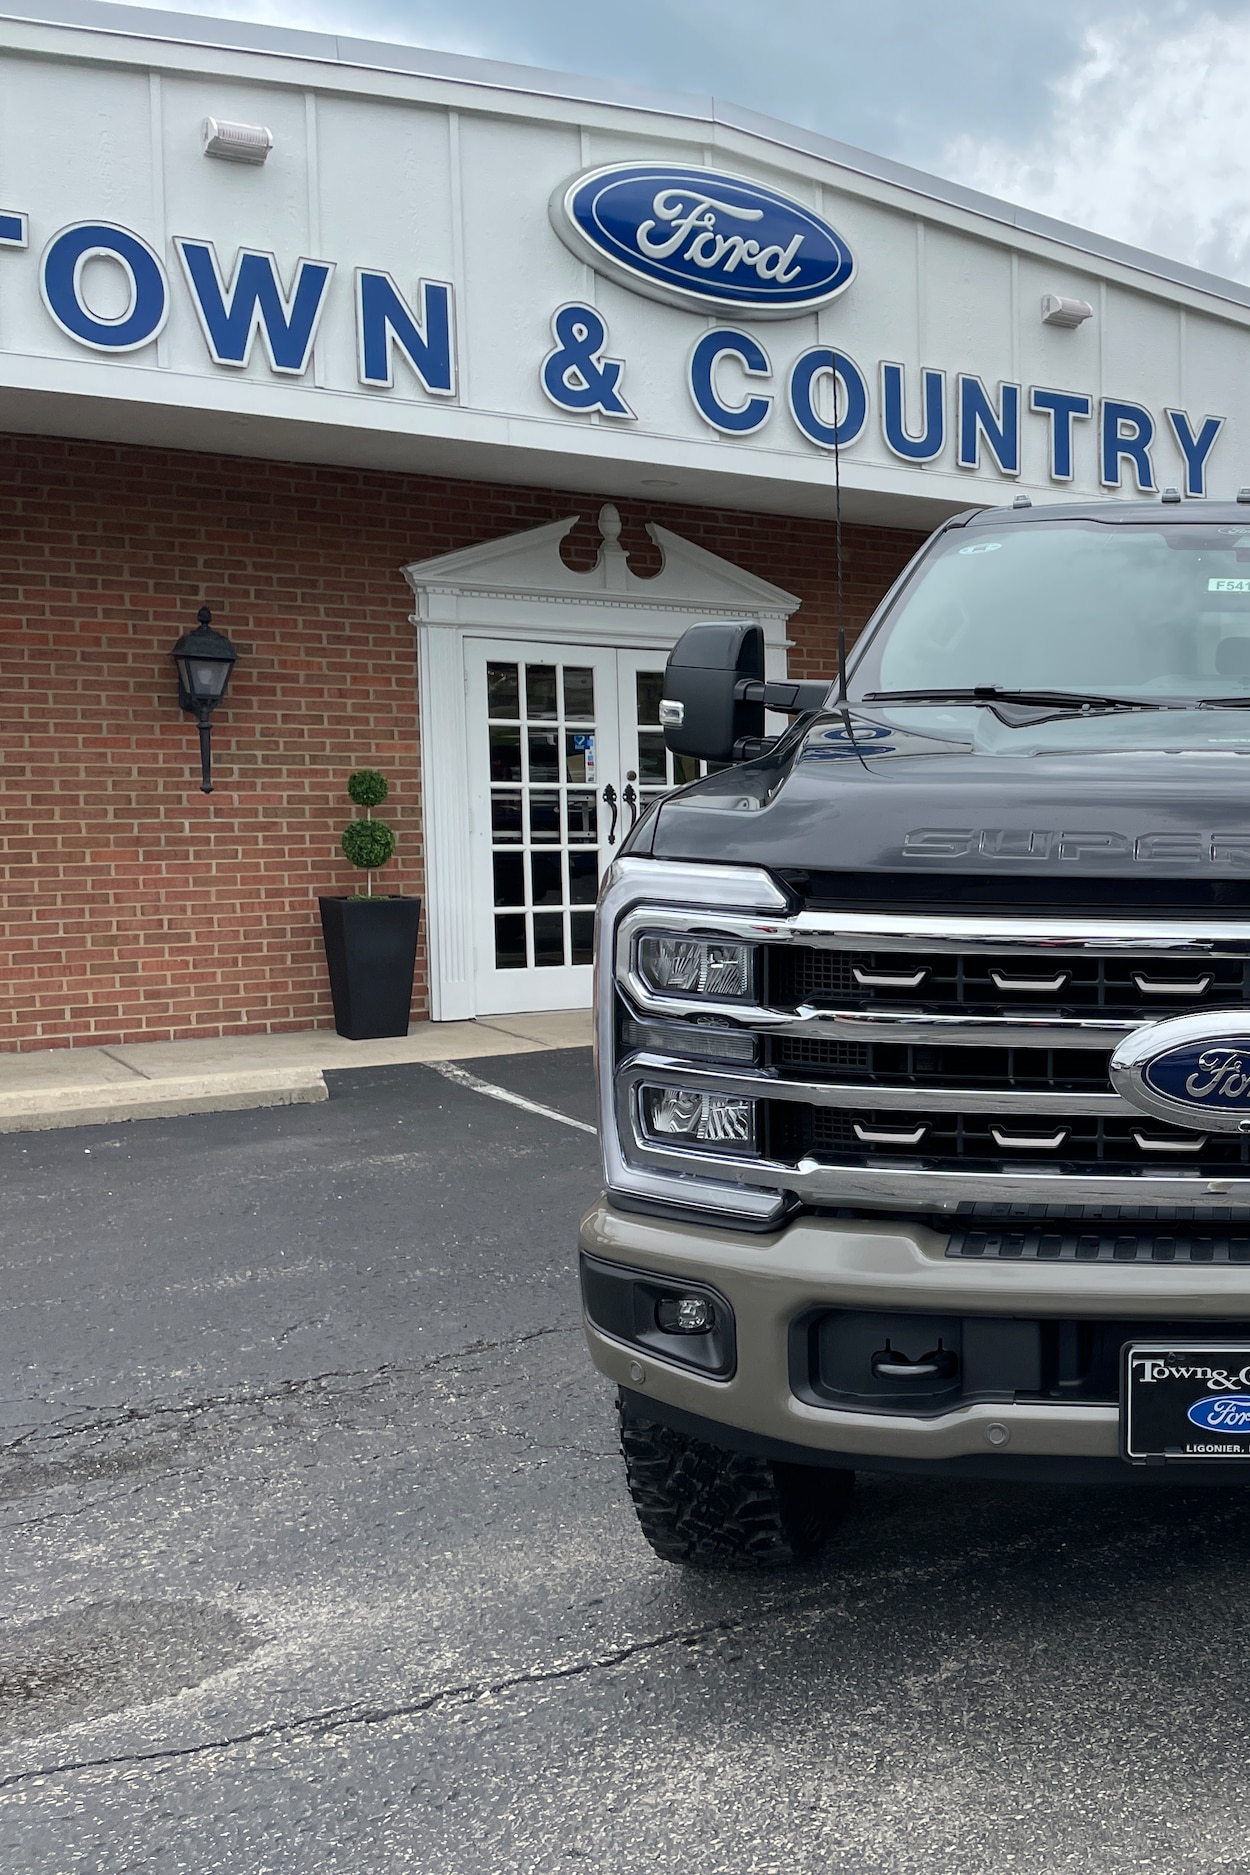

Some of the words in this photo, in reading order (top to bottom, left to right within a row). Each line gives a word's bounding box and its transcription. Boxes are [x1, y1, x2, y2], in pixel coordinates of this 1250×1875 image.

[636, 188, 802, 285] Ford
[0, 209, 457, 398] OWN
[540, 300, 639, 421] &
[686, 326, 1227, 498] COUNTRY
[1132, 1359, 1214, 1383] Town
[1206, 1369, 1241, 1390] &
[1185, 1444, 1245, 1454] LIGONIER,
